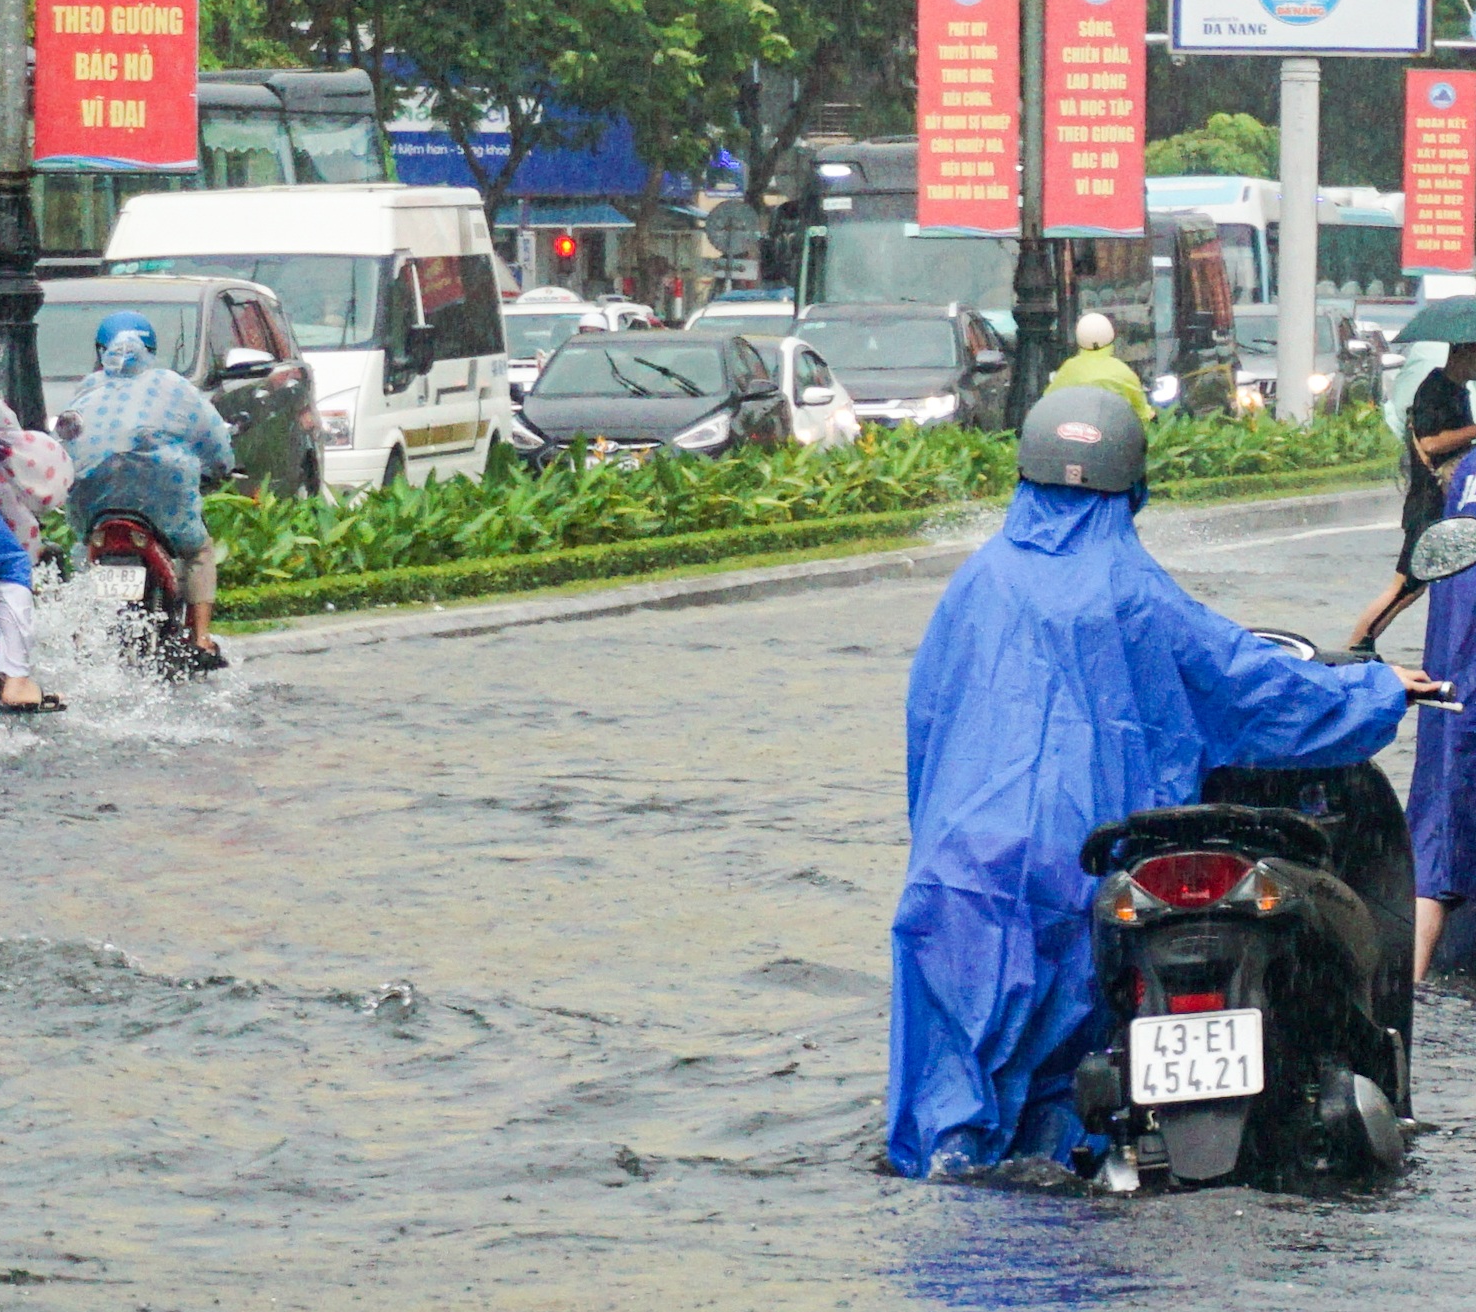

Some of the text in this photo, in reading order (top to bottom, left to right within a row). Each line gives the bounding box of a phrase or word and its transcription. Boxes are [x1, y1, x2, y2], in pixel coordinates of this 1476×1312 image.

[52, 3, 184, 35] THEO GƯƠNG
[75, 44, 154, 81] BÁC HỒ
[80, 95, 146, 134] VĨ ĐẠI
[1154, 1019, 1236, 1057] 43-E1
[1143, 1055, 1248, 1096] 454.21
